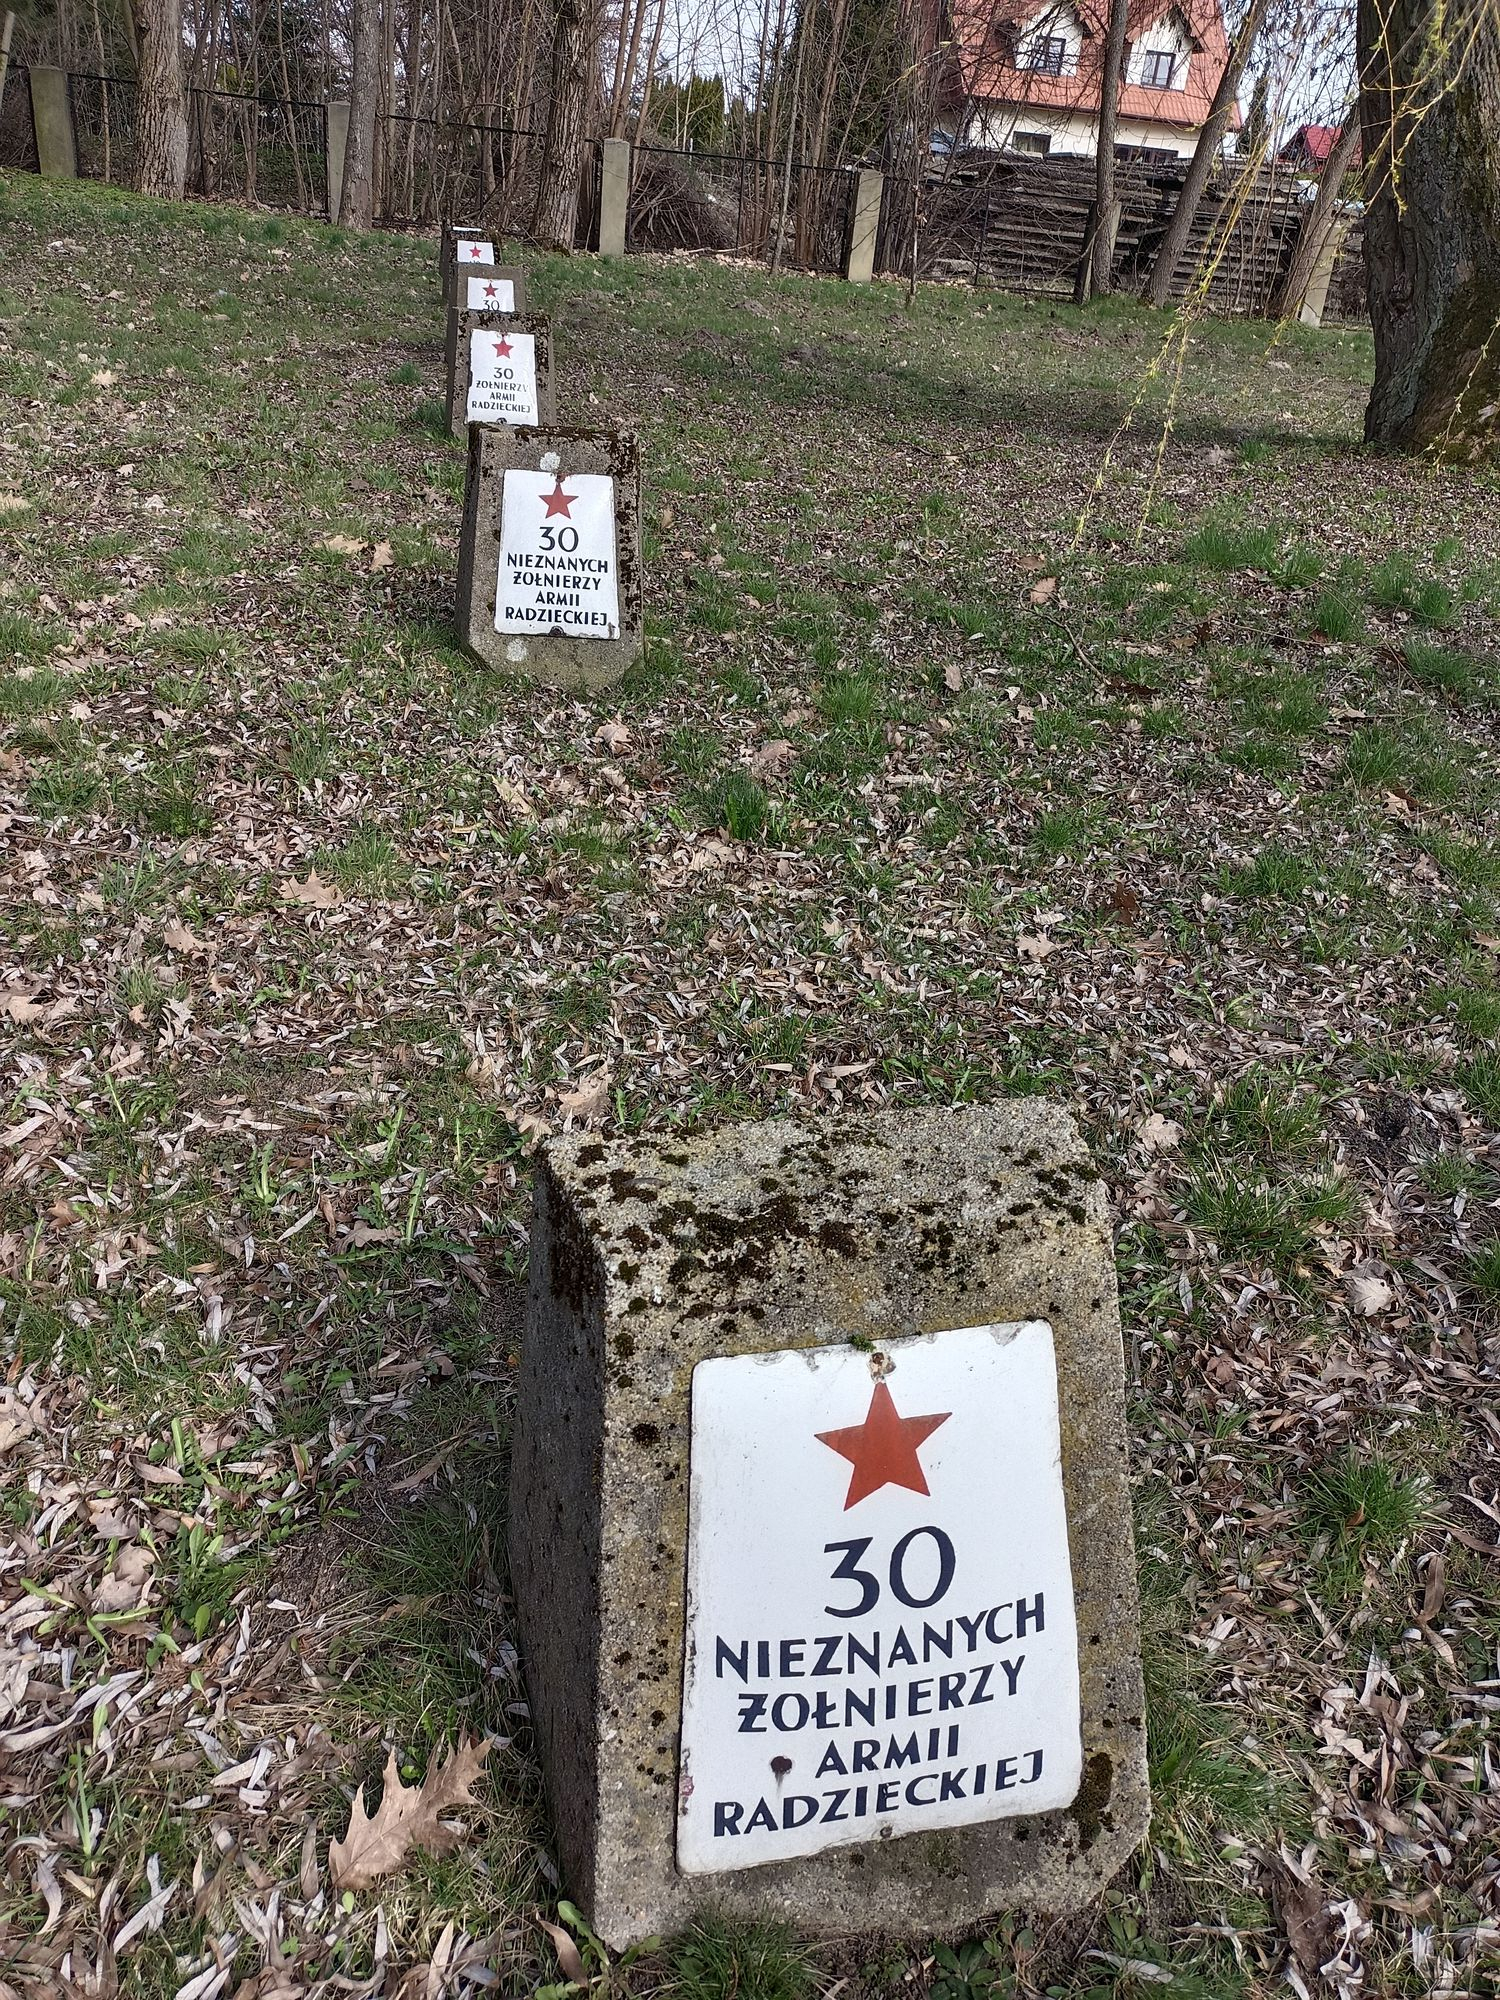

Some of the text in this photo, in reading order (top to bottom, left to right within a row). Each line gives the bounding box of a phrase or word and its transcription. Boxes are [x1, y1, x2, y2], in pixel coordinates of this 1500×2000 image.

[493, 367, 514, 379] 30
[471, 400, 531, 413] RADZIECKIEJ
[489, 391, 515, 402] ARMII
[538, 526, 579, 552] 30
[507, 552, 608, 573] NIEZNANYCH
[535, 590, 580, 607] ARMII
[505, 606, 608, 626] RADZIECKIEJ
[823, 1525, 957, 1619] 30
[715, 1592, 1046, 1684] NIEZNANYCH
[815, 1724, 960, 1778] ARMII
[713, 1749, 1044, 1837] RADZIECKIEJ
